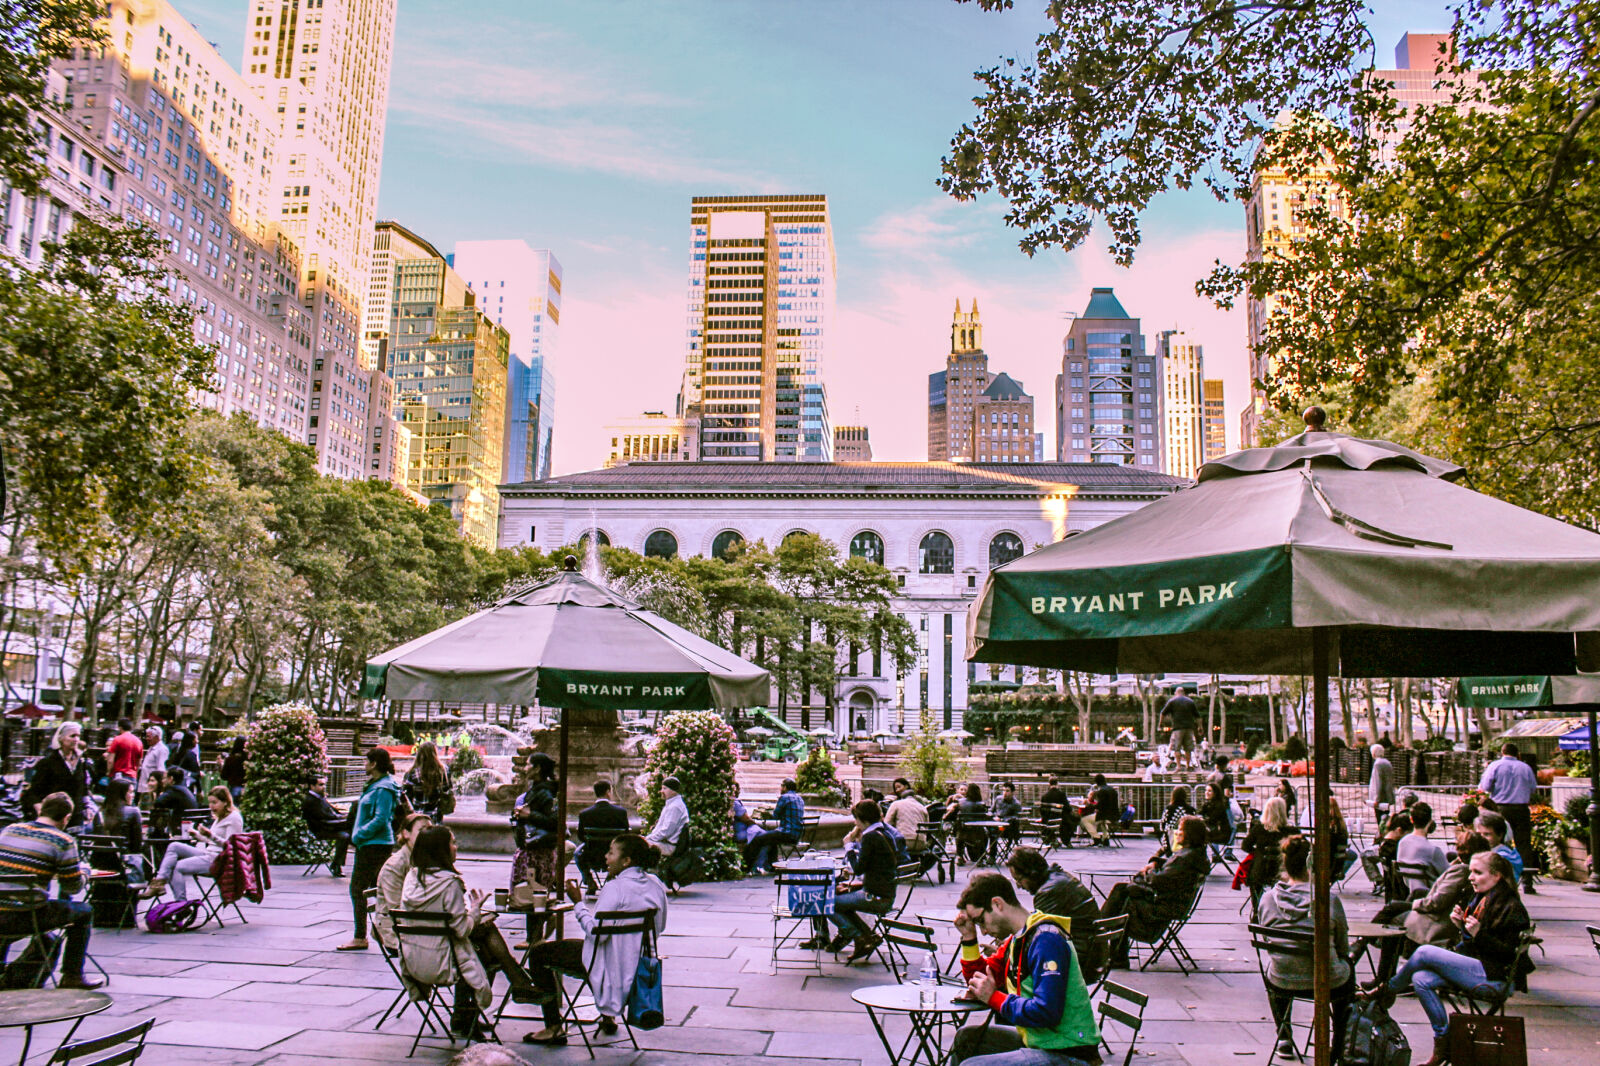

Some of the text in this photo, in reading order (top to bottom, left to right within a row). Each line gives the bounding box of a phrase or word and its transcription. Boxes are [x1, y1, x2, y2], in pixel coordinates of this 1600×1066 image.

[1031, 581, 1238, 614] BRYANT PARK
[566, 683, 686, 696] BRYANT PARK
[1471, 683, 1540, 695] BRYANT PARK
[808, 901, 835, 915] Art
